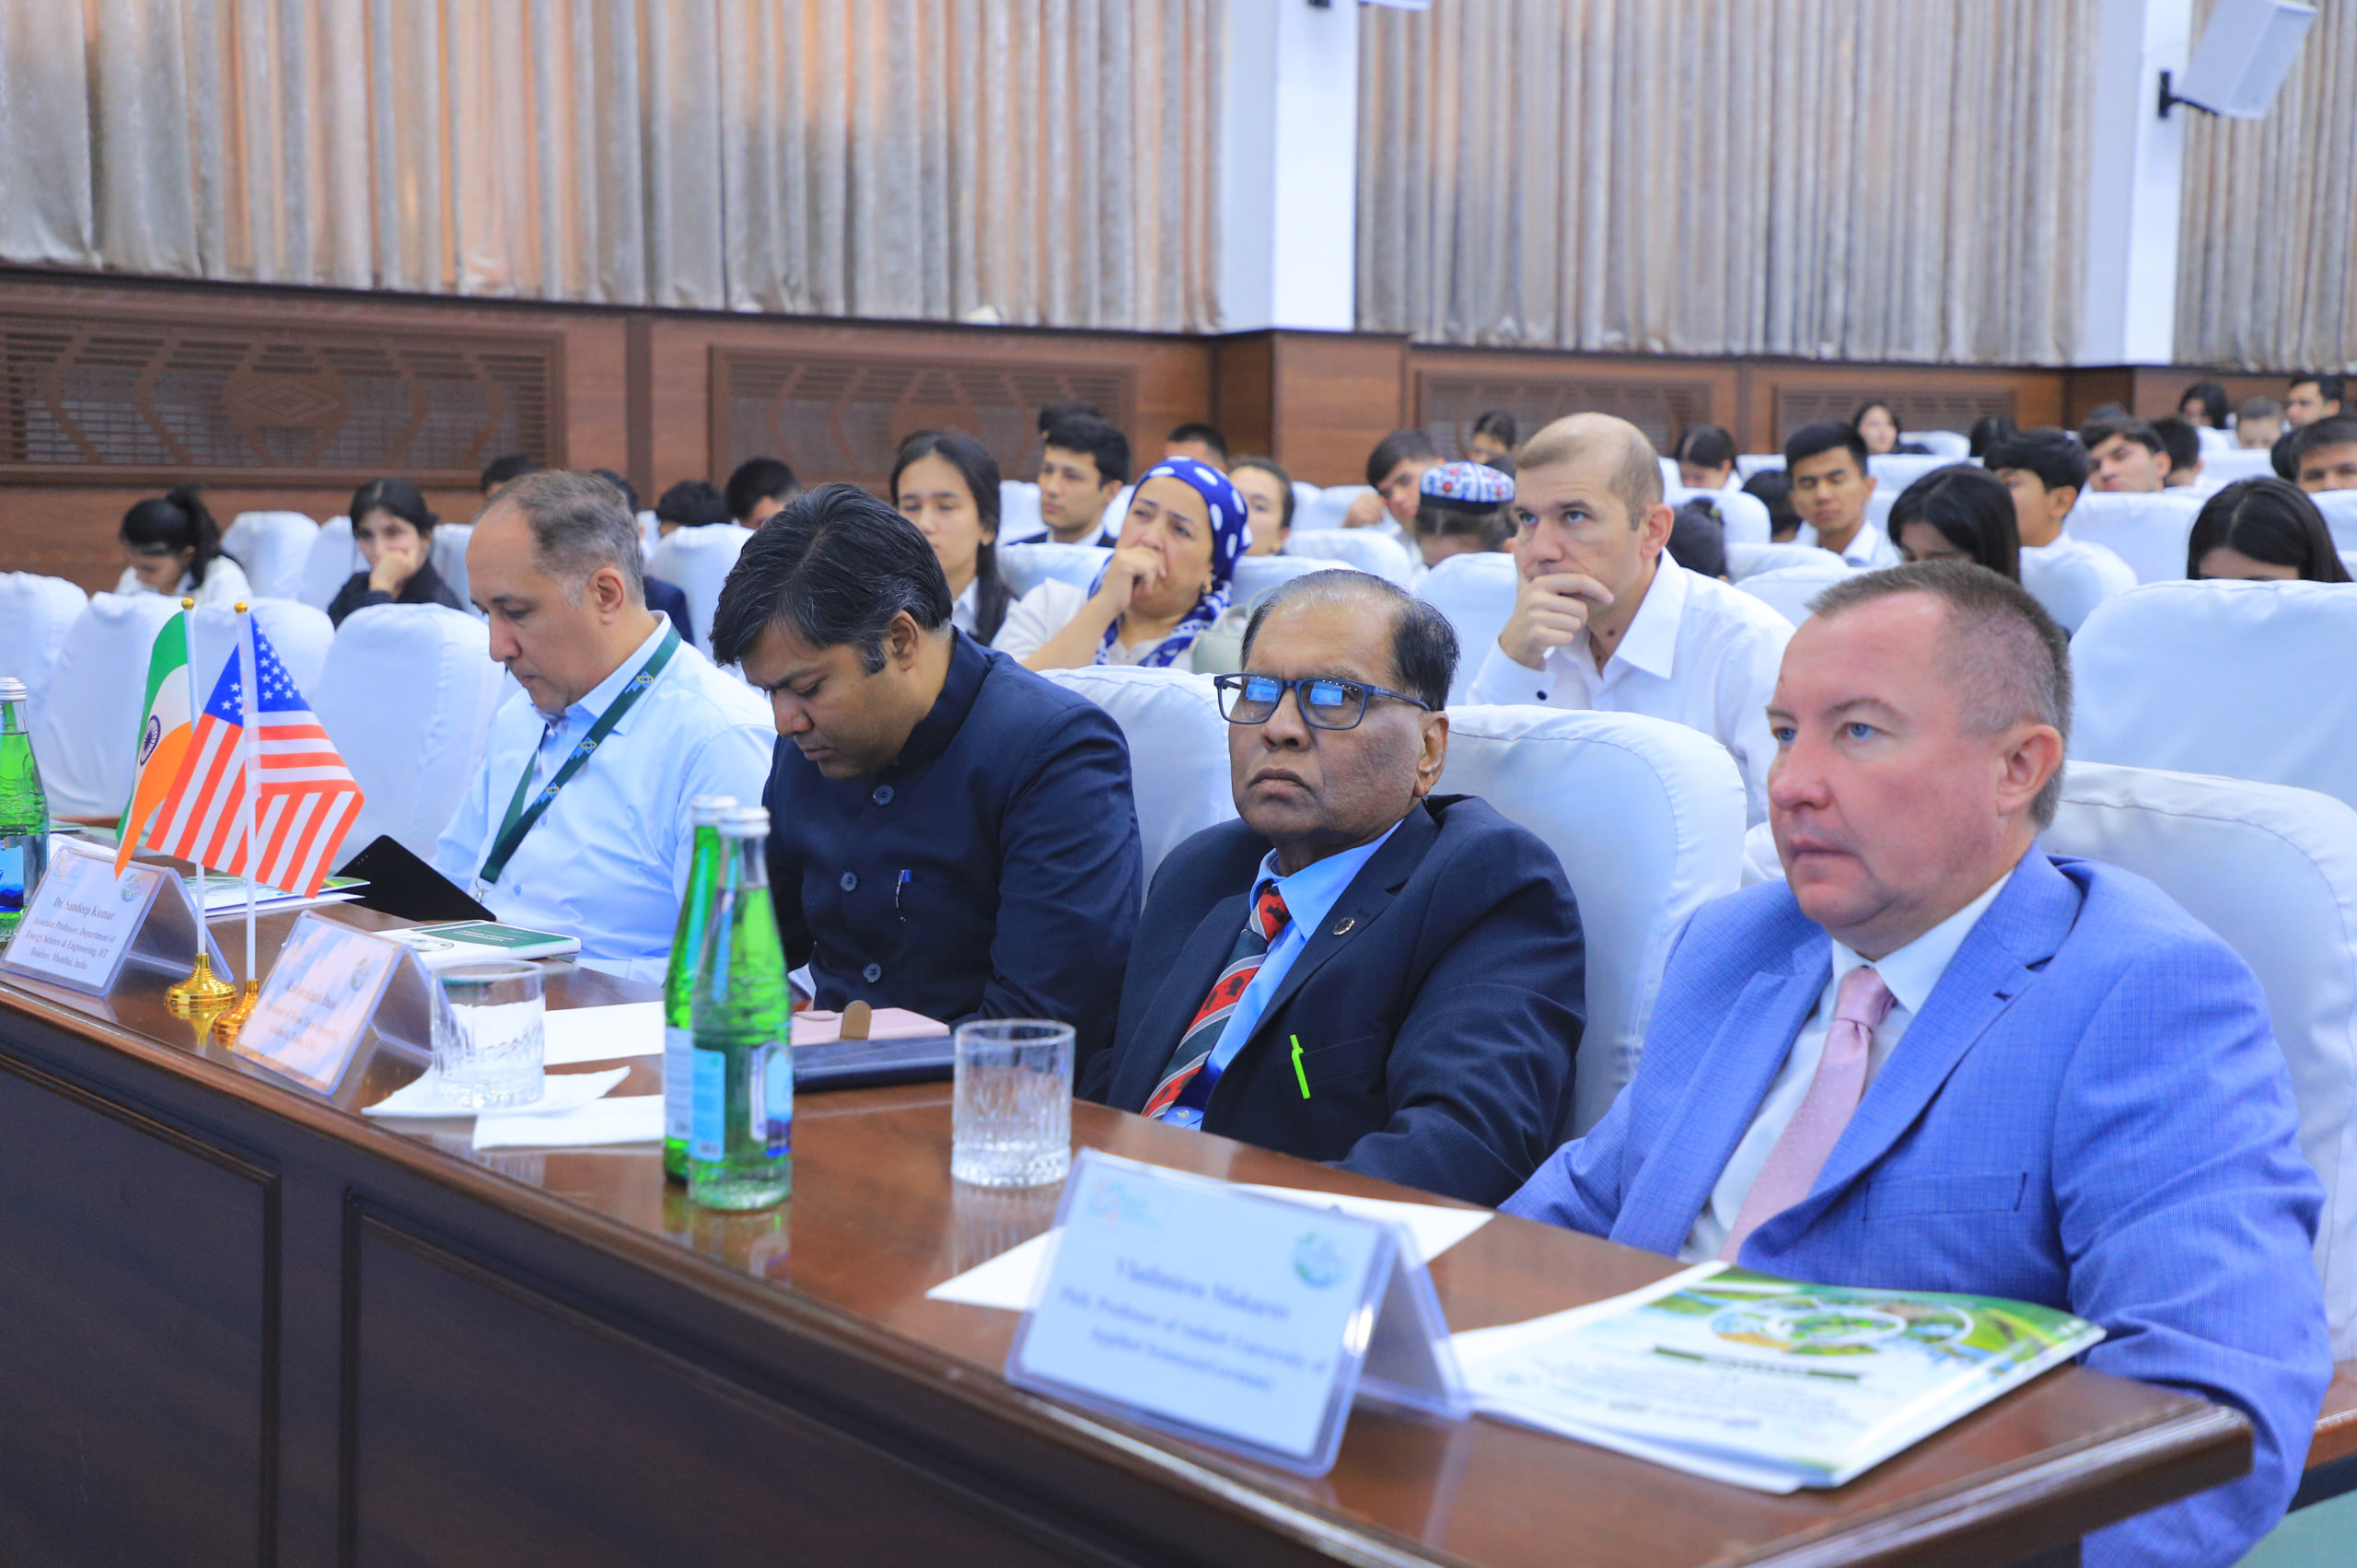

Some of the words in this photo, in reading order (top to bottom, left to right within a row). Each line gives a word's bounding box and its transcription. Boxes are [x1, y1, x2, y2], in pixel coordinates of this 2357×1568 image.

[52, 897, 64, 909] Dr.
[64, 900, 90, 917] Sandeep
[91, 905, 115, 921] Kumar
[109, 935, 118, 944] of
